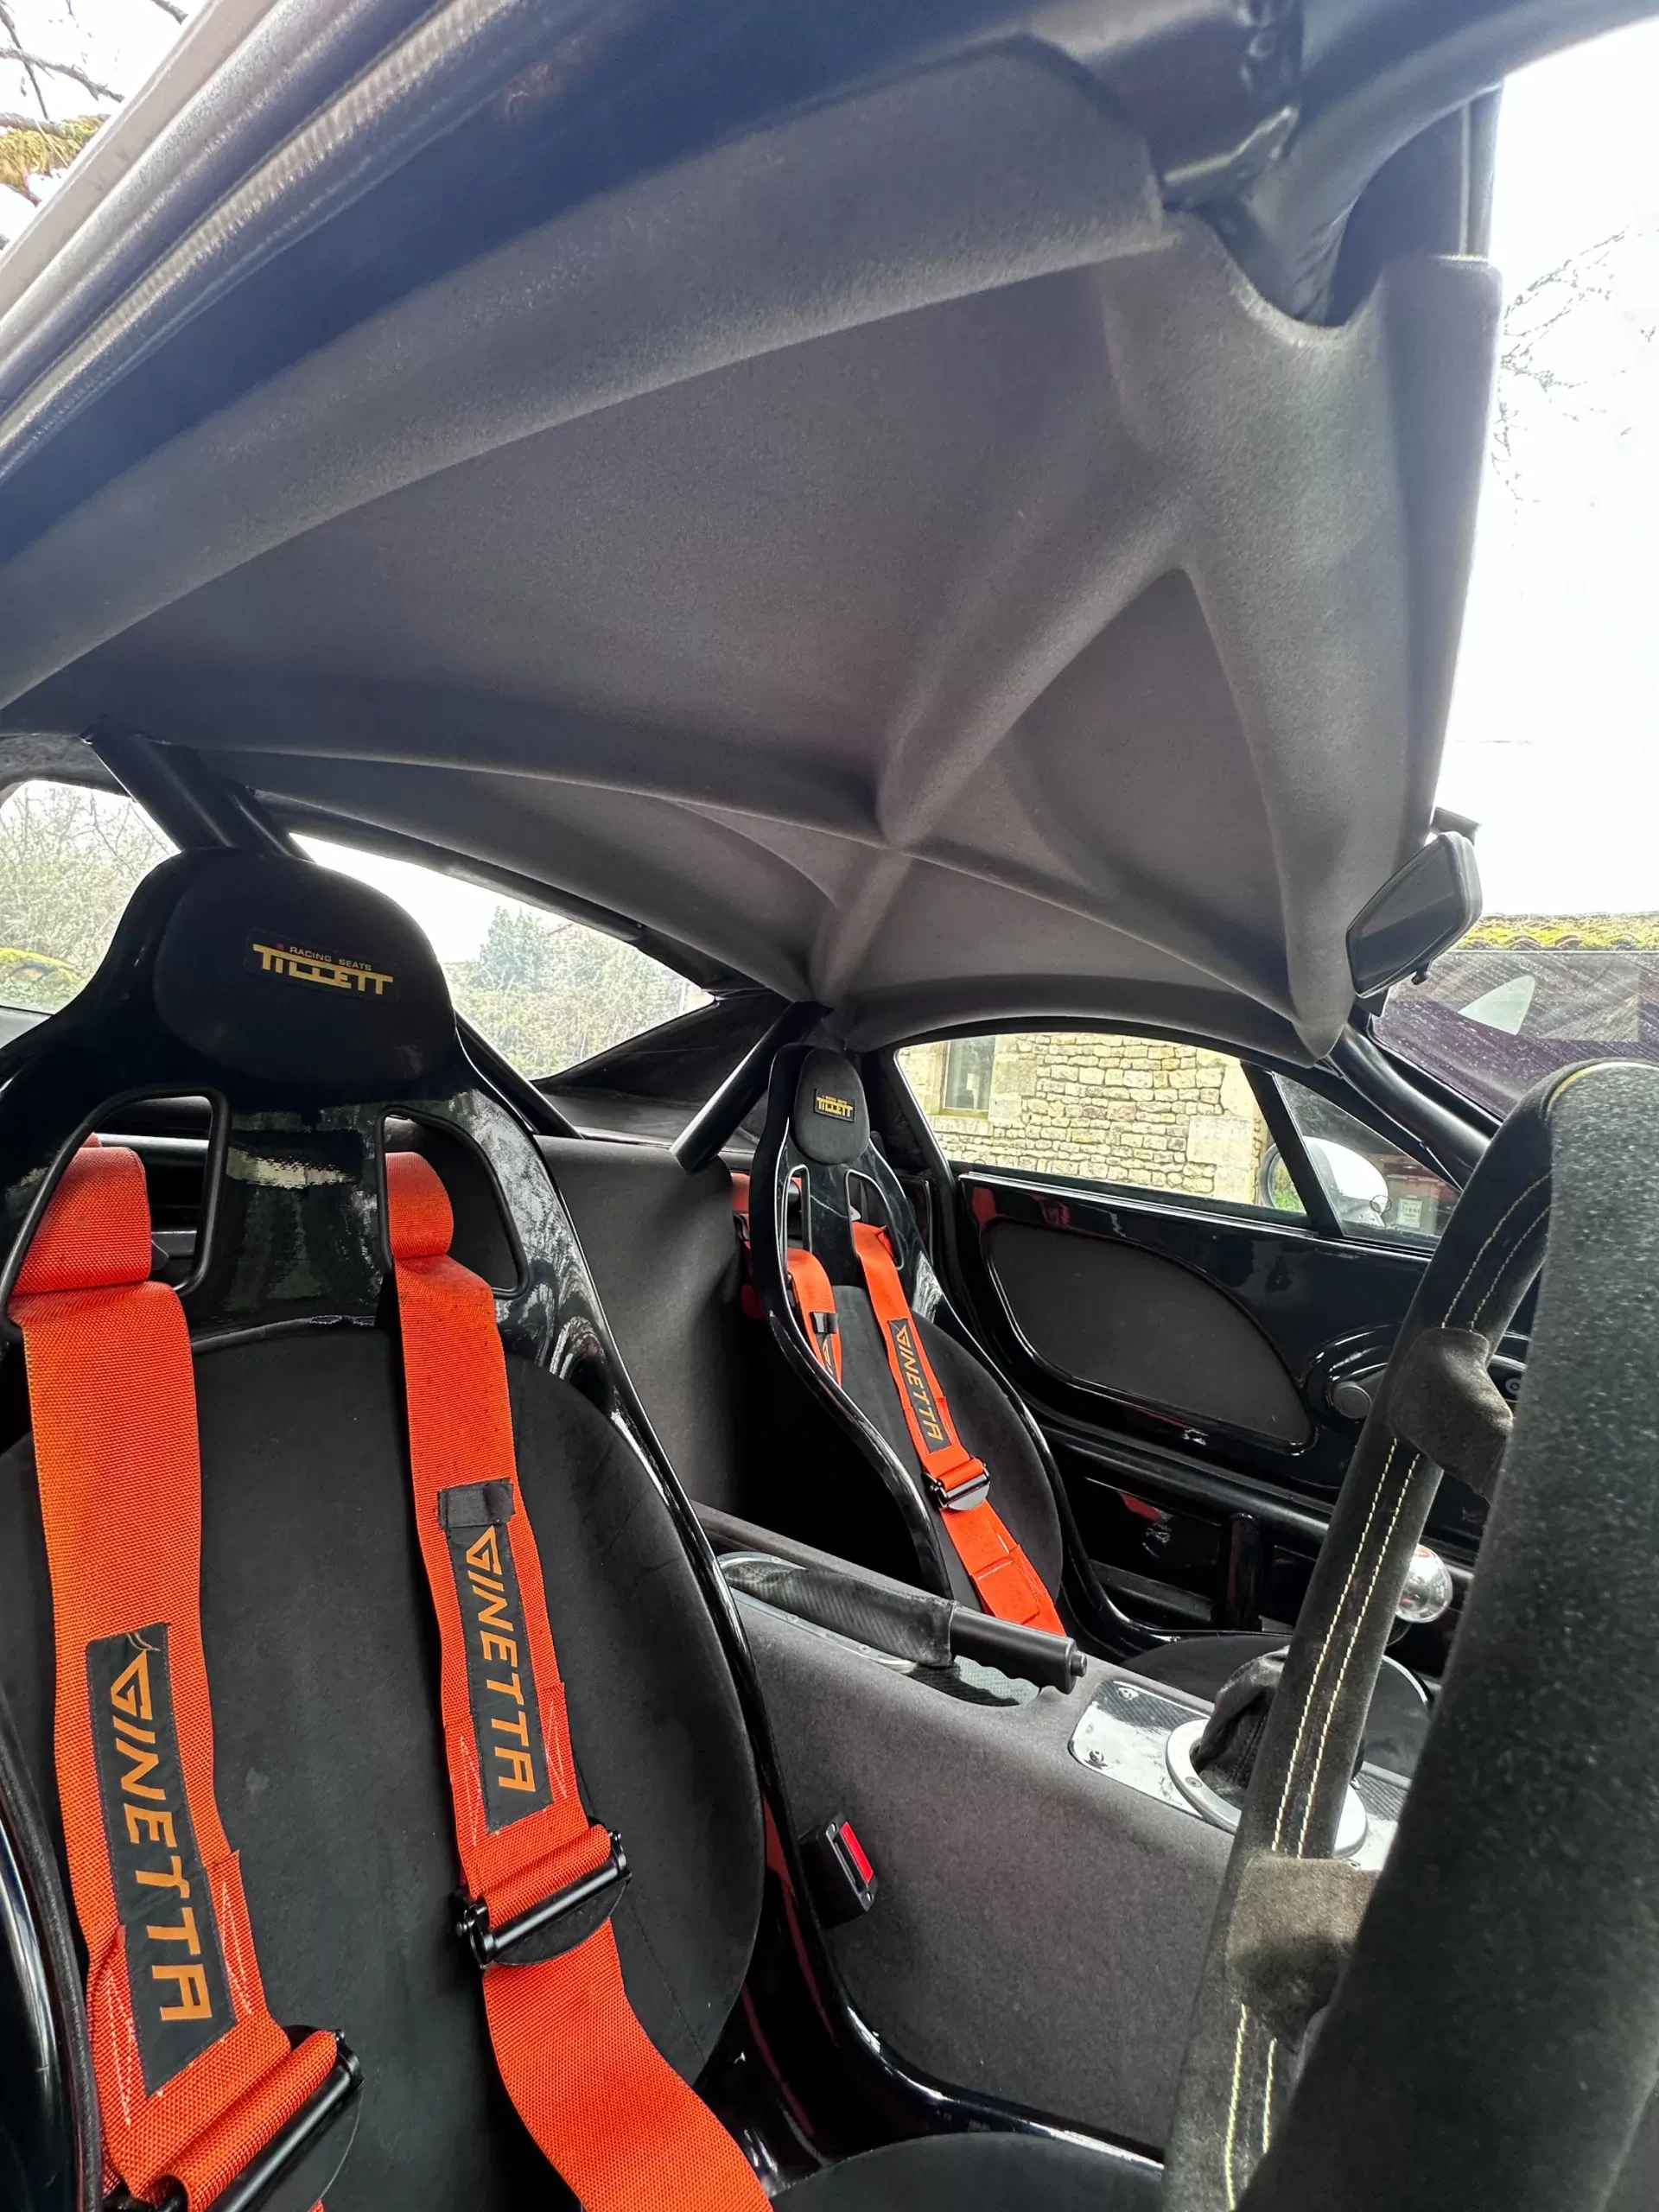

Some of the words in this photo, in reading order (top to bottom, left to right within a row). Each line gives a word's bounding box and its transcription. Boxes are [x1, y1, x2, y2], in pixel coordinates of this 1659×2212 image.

[252, 943, 394, 995] TILLETT
[289, 946, 332, 963] RACING
[338, 958, 372, 971] SEATS
[817, 1096, 853, 1117] TILLETT
[896, 1324, 944, 1441] GINETTA
[466, 1525, 536, 1793] GINETTA
[110, 1649, 213, 2021] GINETTA
